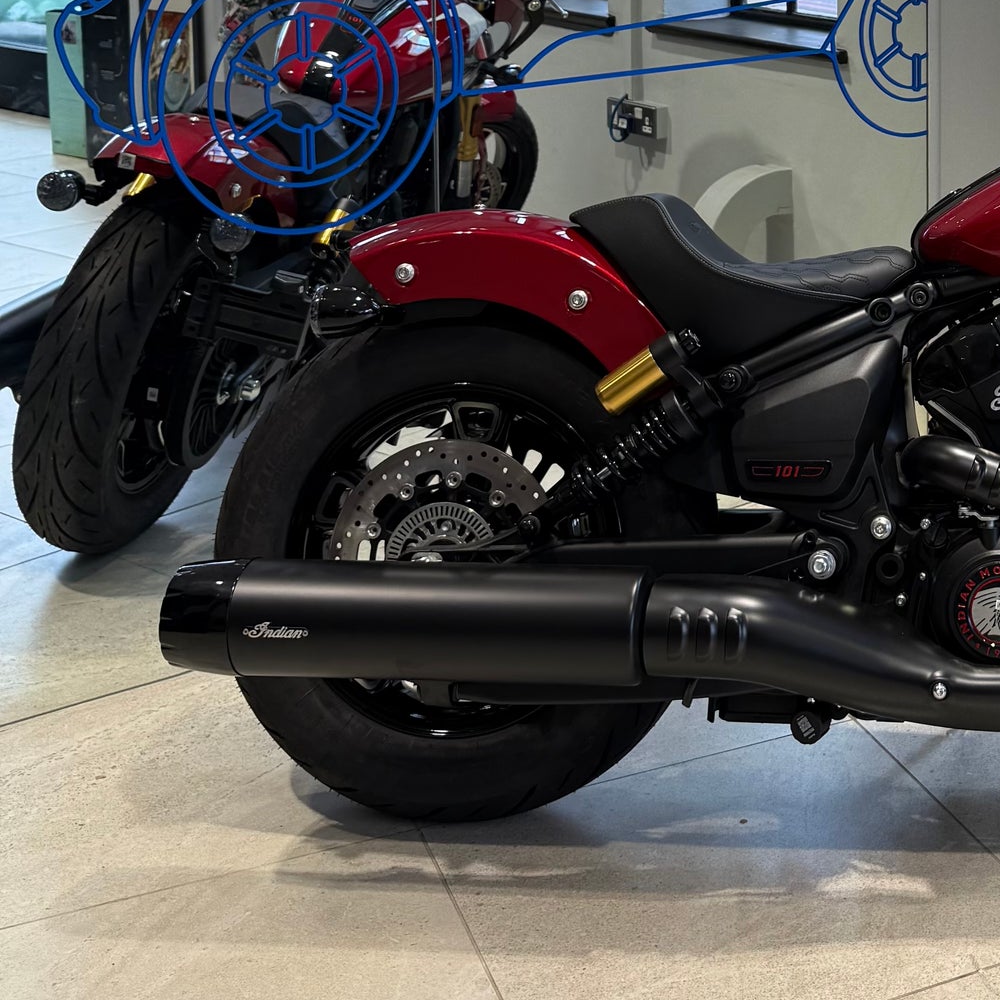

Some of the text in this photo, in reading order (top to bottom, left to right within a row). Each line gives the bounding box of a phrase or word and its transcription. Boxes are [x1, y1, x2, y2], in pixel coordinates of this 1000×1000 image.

[775, 465, 800, 478] 101
[957, 579, 976, 640] INDIAN
[248, 621, 303, 639] Indian
